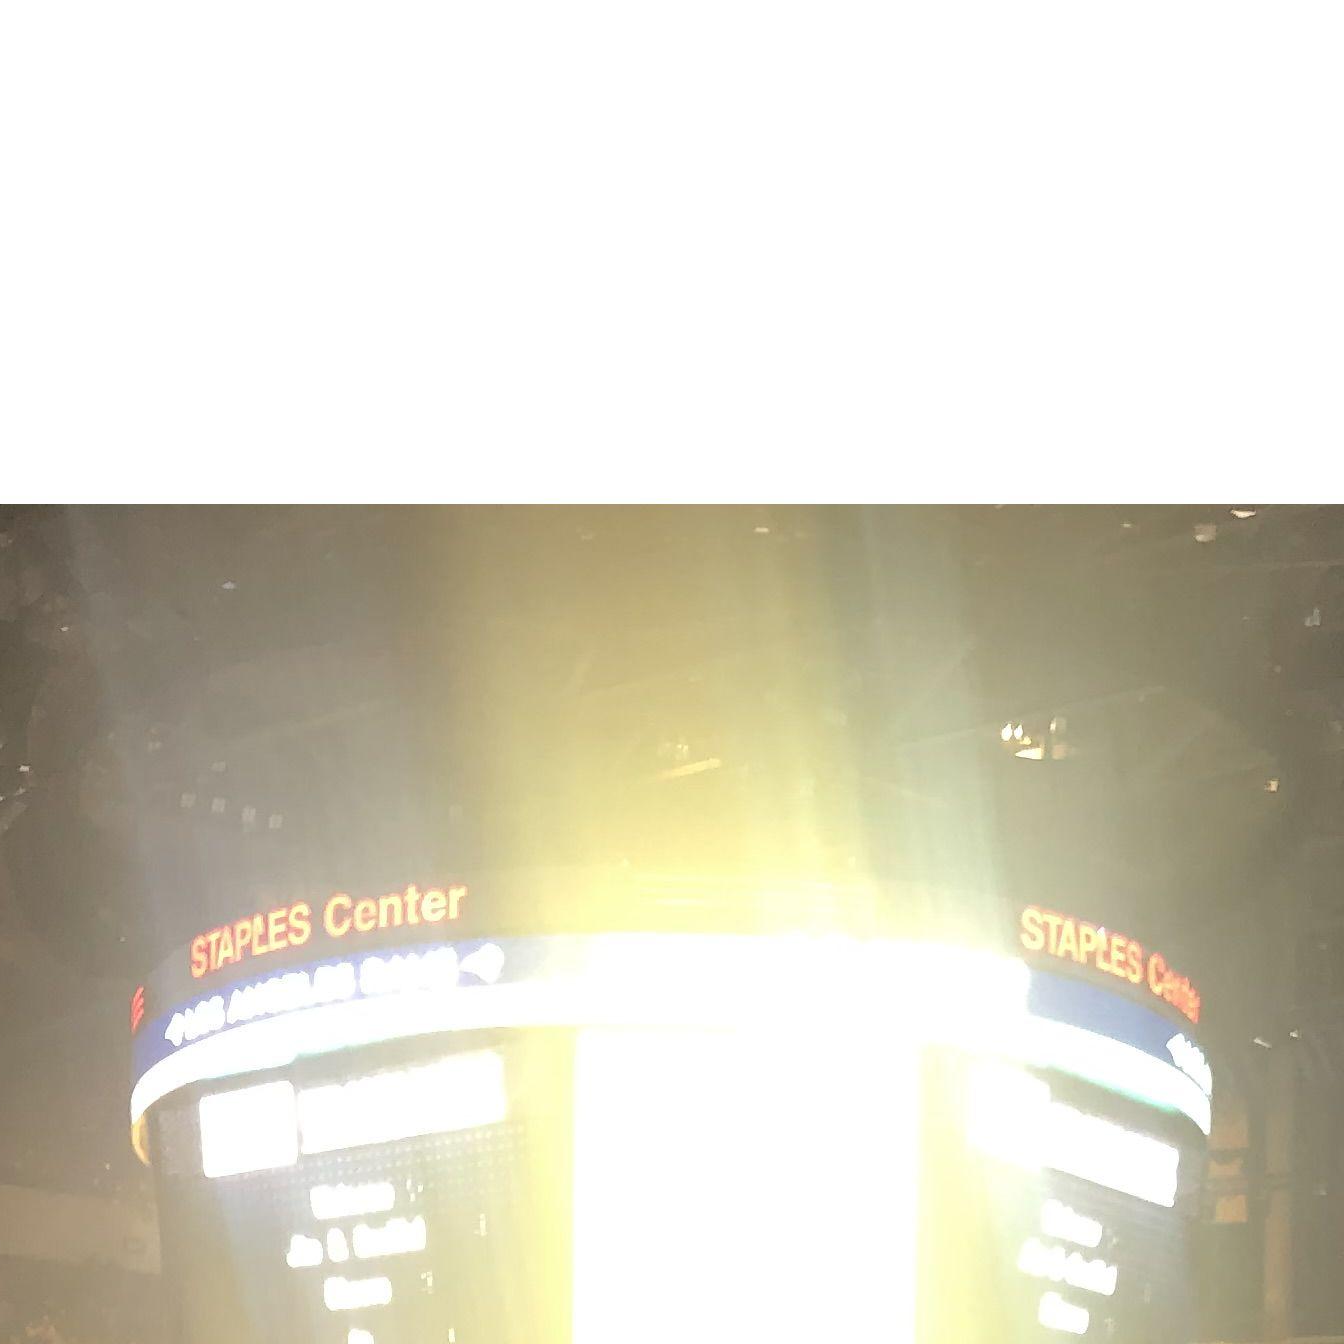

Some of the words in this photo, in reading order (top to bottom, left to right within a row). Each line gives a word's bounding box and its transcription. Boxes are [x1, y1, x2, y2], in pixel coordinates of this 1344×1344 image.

[190, 901, 312, 979] STAPLES
[323, 883, 468, 938] Center
[1020, 905, 1144, 984] STAPLES
